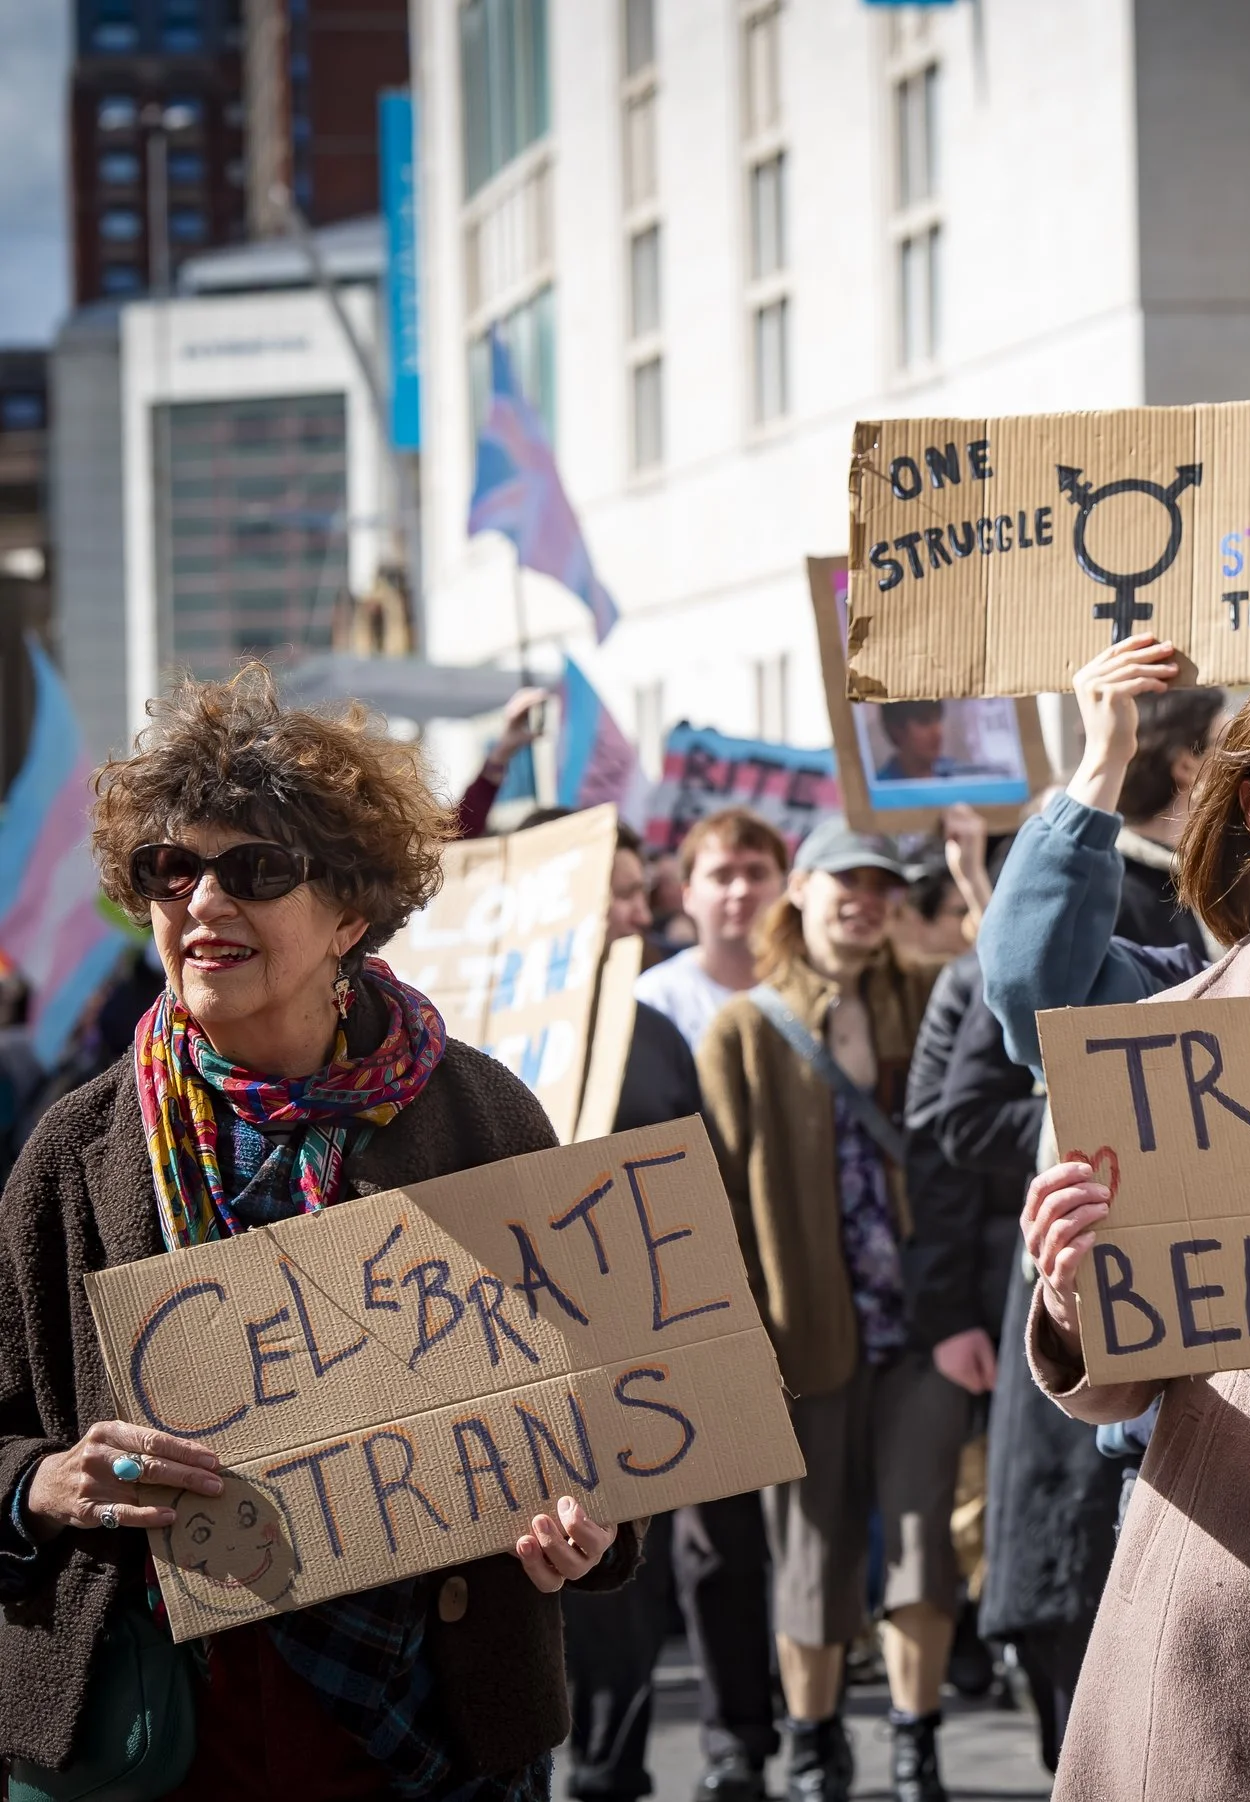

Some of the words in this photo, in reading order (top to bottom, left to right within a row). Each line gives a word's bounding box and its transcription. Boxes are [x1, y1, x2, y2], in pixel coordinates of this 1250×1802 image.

[888, 439, 994, 501] ONE
[868, 506, 1054, 592] STRUGGLE
[265, 1362, 697, 1559] TRANS
